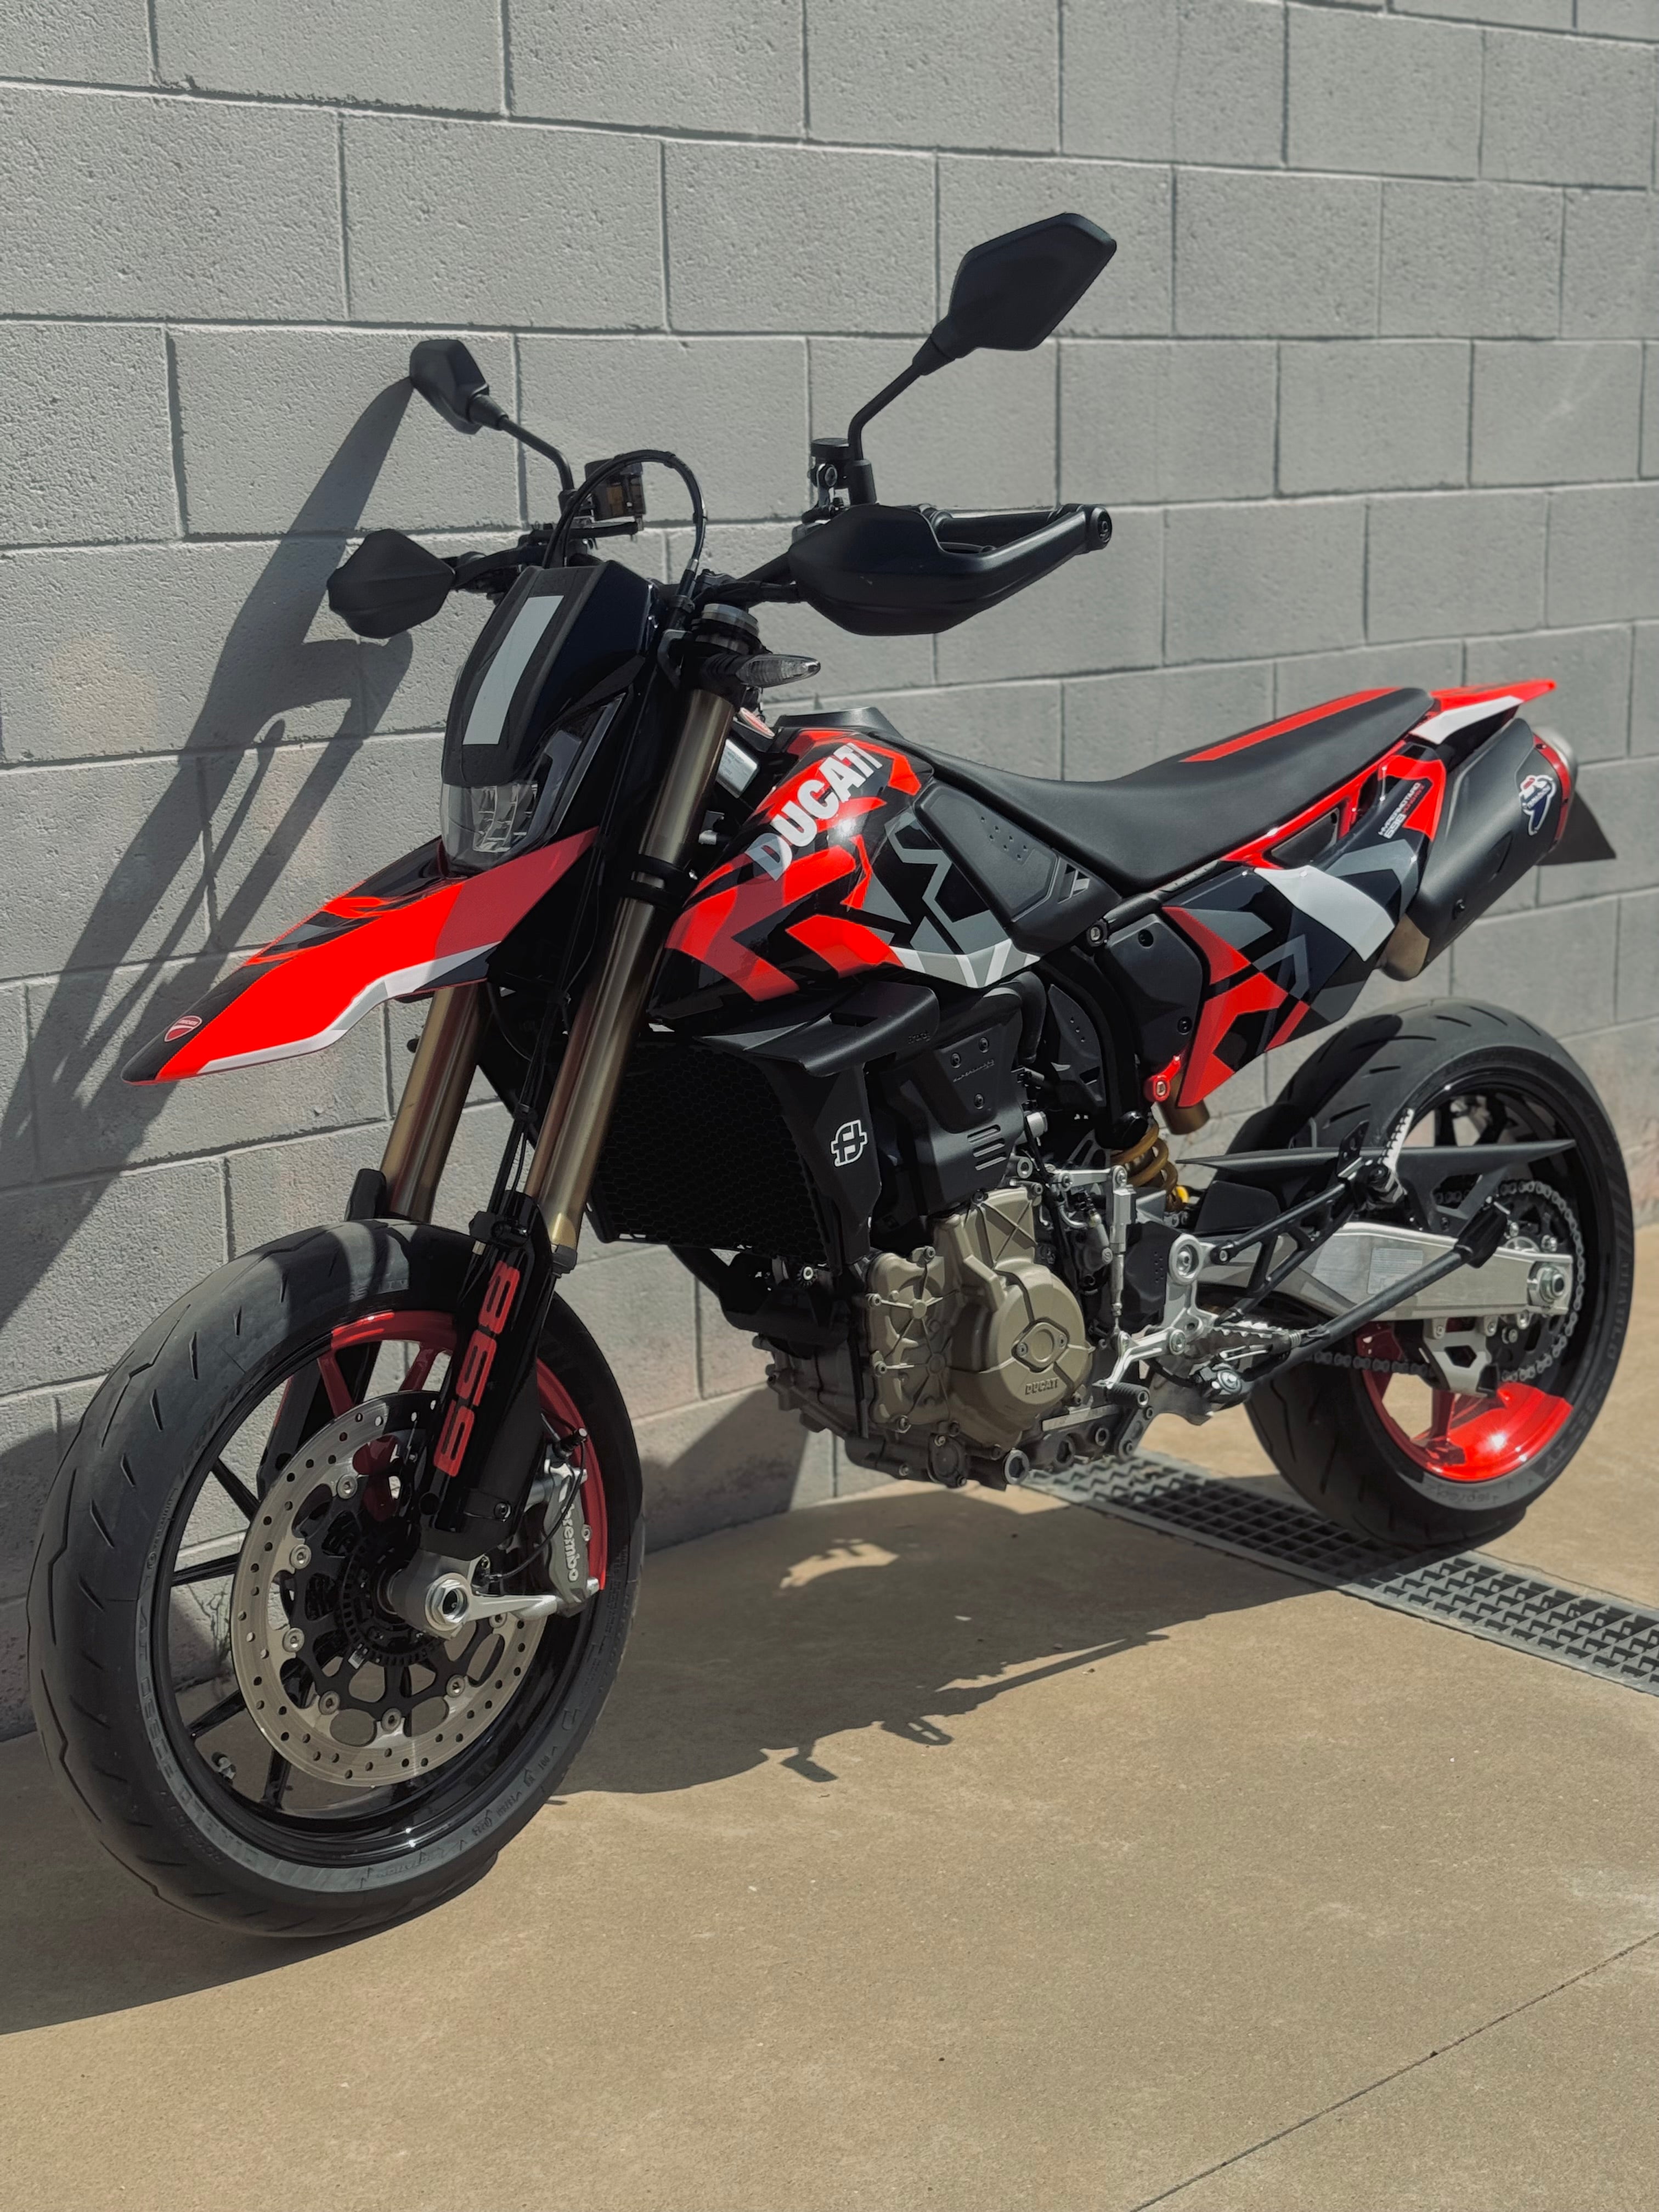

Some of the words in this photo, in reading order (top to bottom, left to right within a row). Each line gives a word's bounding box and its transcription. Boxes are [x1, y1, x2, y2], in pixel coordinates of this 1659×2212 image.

[744, 742, 883, 882] DUCATI
[1383, 812, 1407, 839] 698
[1025, 1376, 1059, 1395] DUCATI
[561, 1503, 580, 1582] brembo
